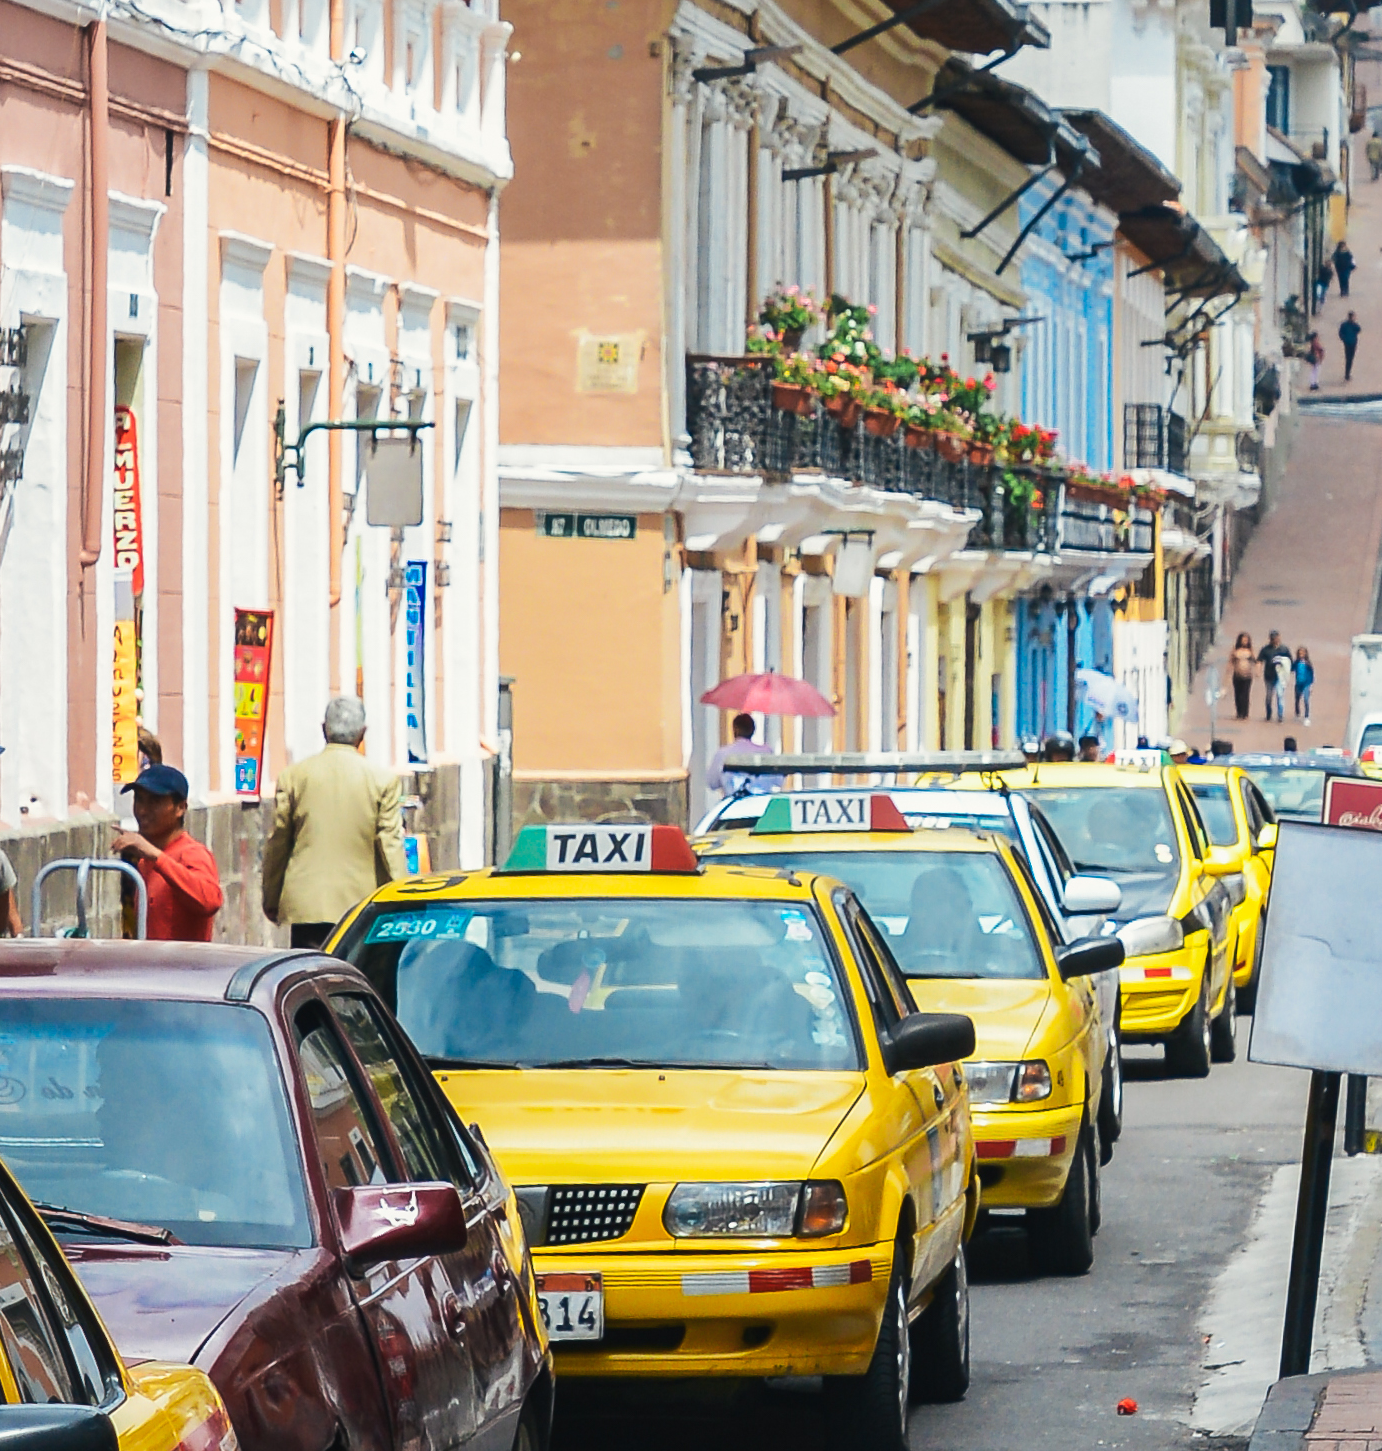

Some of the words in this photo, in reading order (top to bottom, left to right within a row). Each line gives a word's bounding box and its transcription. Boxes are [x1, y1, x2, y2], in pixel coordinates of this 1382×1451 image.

[1117, 757, 1156, 767] TAXI
[794, 799, 865, 824] TAXI
[553, 832, 646, 863] TAXI
